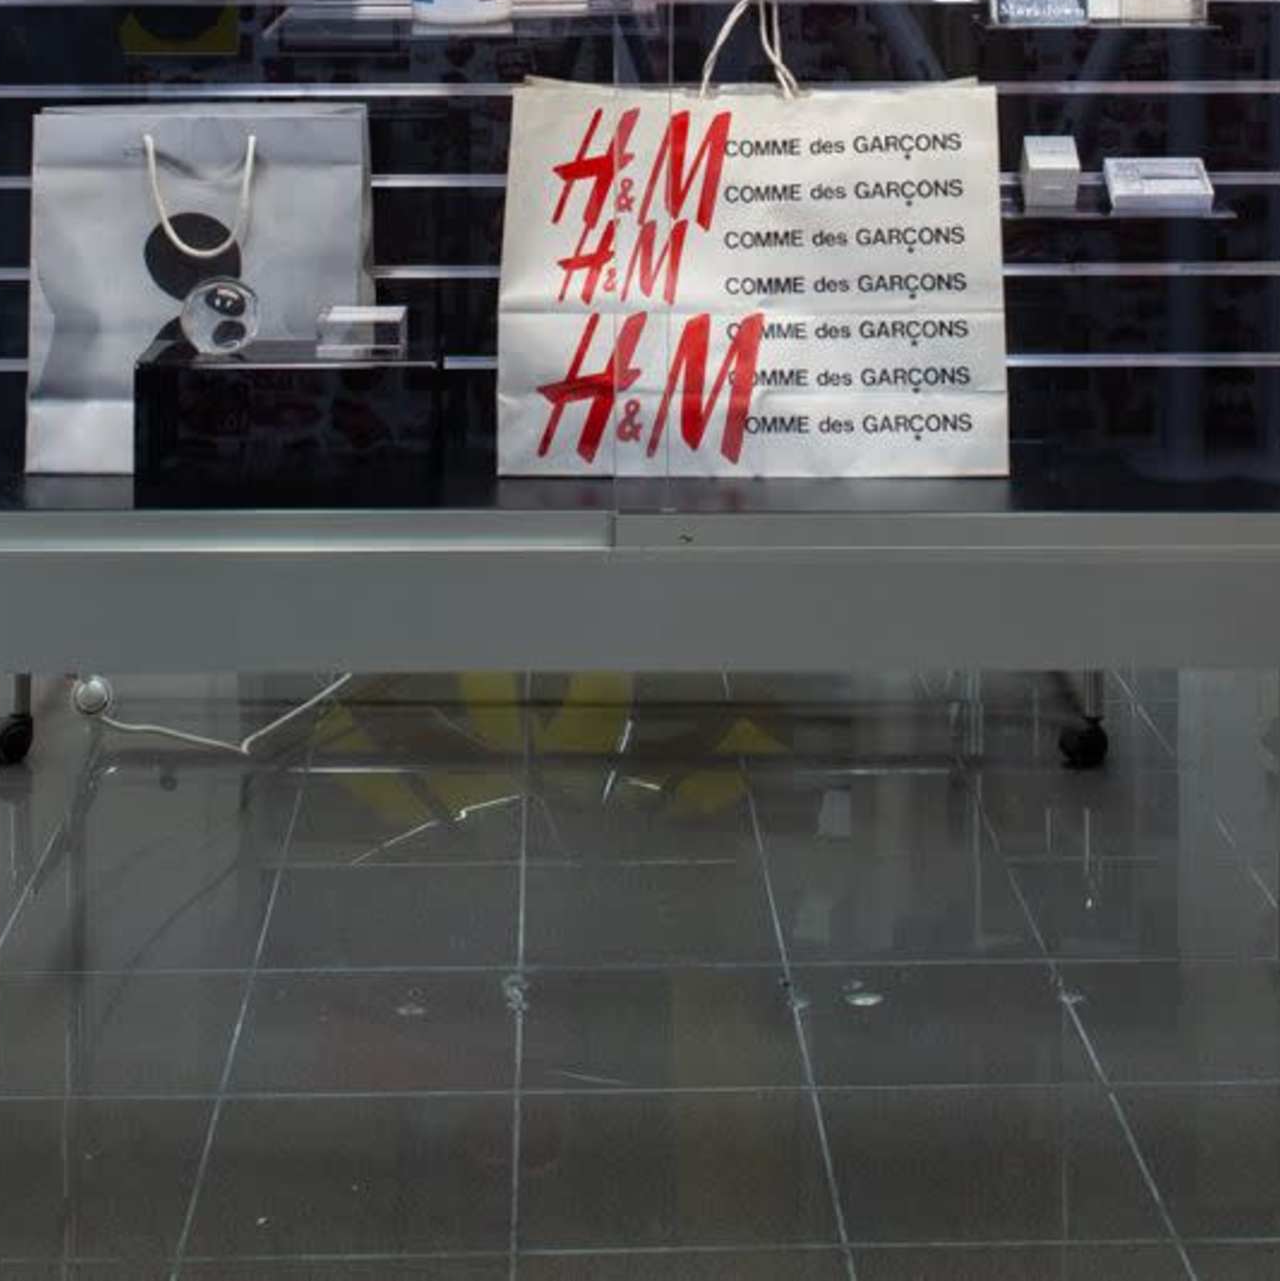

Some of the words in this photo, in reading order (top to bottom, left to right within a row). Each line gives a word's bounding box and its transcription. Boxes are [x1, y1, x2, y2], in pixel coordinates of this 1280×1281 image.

[723, 138, 801, 157] COMME
[809, 136, 845, 155] des
[852, 133, 963, 160] GARÇONS
[553, 106, 732, 232] H&M
[724, 183, 802, 204] COMME
[810, 182, 847, 200] des
[854, 179, 964, 207] GARÇONS
[724, 229, 804, 249] COMME
[812, 228, 848, 247] des
[855, 226, 966, 253] GARÇONS
[557, 219, 689, 307] H&M
[725, 277, 805, 295] COMME
[813, 276, 850, 293] des
[857, 273, 968, 299] GARÇONS
[726, 322, 807, 340] CMME
[815, 322, 852, 339] des
[859, 320, 969, 346] GARÇONS
[536, 311, 764, 465] H&M
[816, 368, 853, 386] des
[860, 366, 971, 394] GARÇONS
[818, 415, 854, 433] des
[862, 413, 972, 441] GARÇONS
